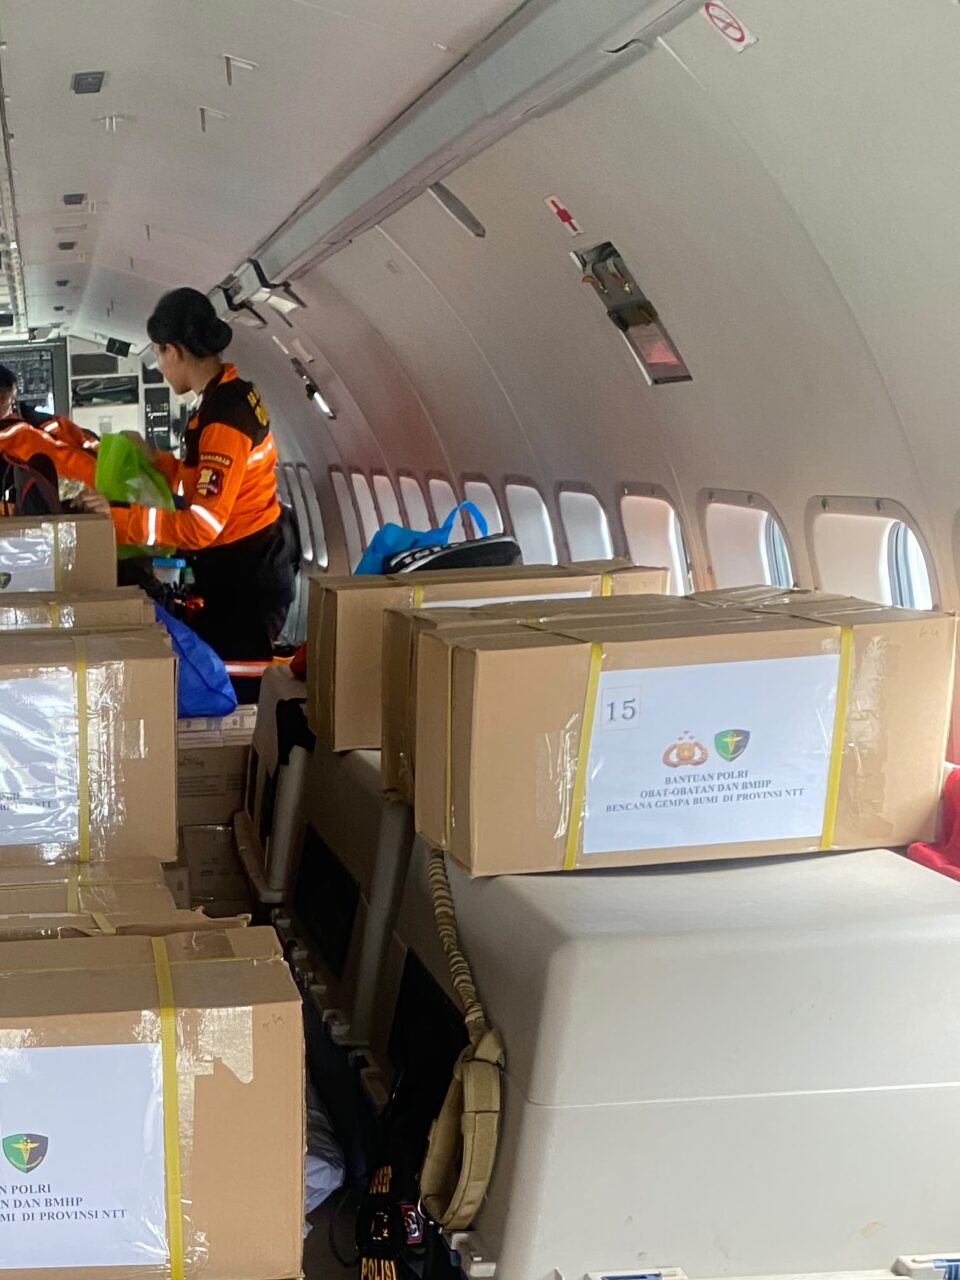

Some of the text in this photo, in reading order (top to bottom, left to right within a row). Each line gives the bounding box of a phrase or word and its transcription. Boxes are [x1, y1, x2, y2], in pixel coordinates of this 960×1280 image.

[606, 698, 636, 722] 15
[664, 769, 749, 786] BANTUAN POLRI
[640, 780, 772, 799] OBAT-OBATAN DAN BMHP
[605, 788, 805, 813] BENCANA GEMPA BUMI DI PROVINSI NTT
[11, 1183, 52, 1195] POLRI
[13, 1198, 41, 1210] DAN
[44, 1196, 83, 1207] BMHP
[22, 1211, 35, 1221] DI
[40, 1209, 99, 1221] PROVINSI
[101, 1208, 127, 1219] NTT
